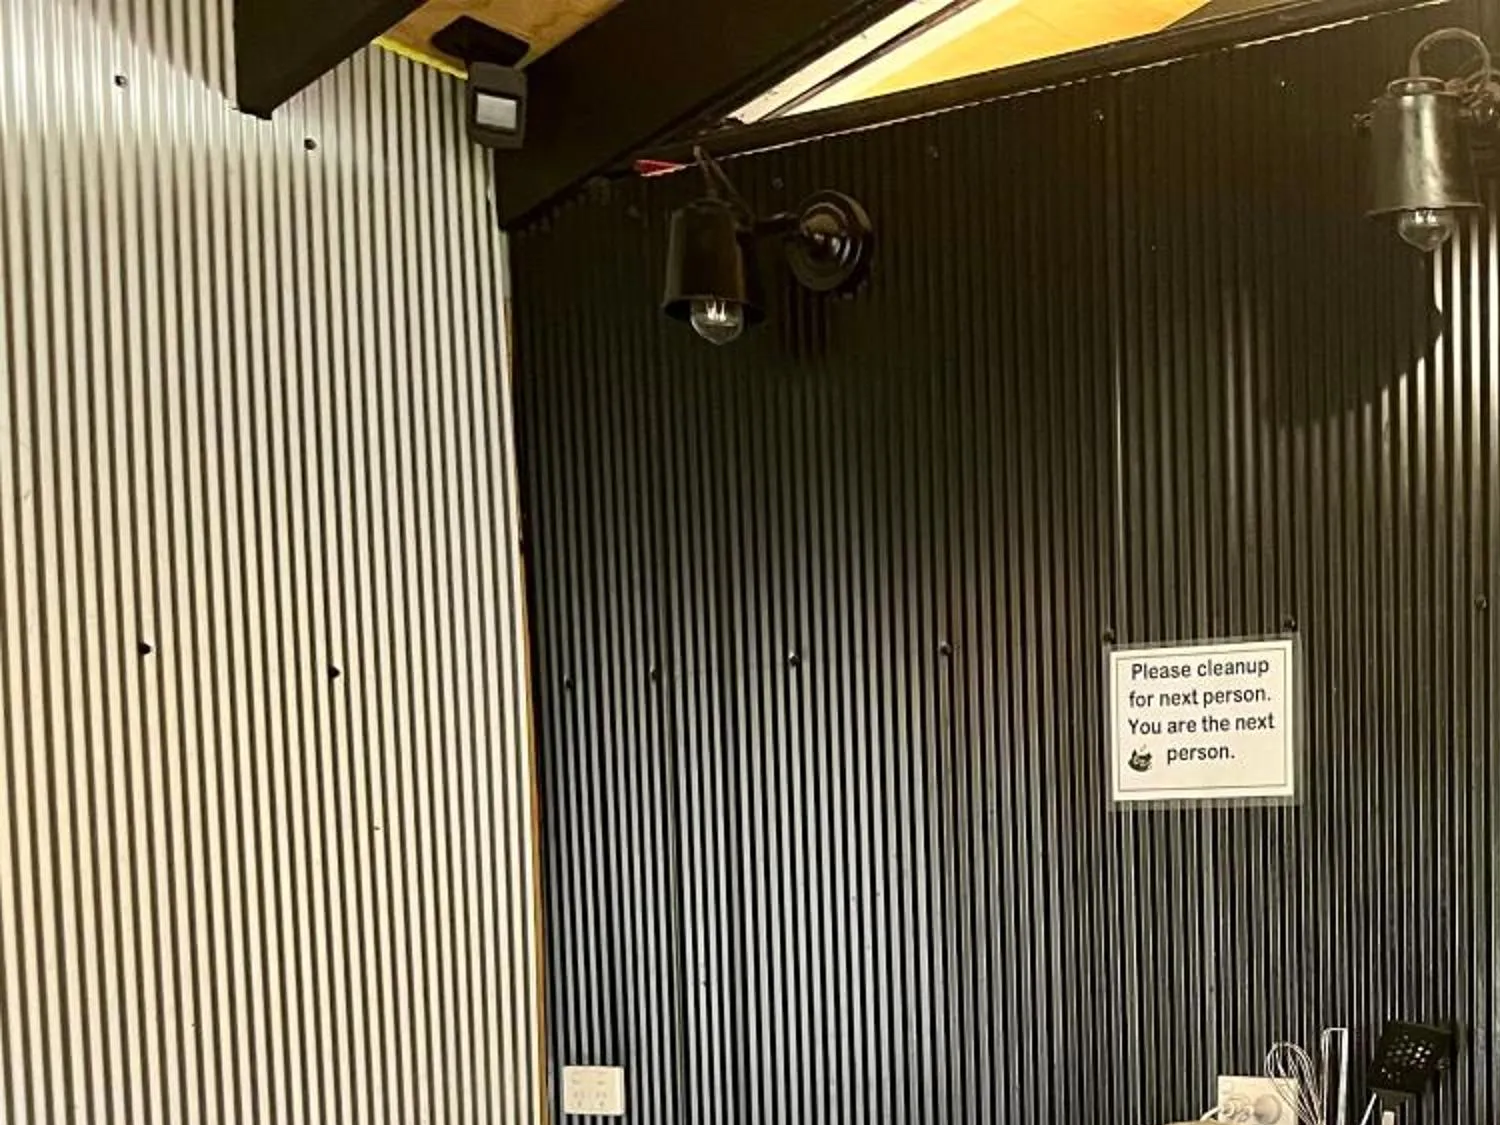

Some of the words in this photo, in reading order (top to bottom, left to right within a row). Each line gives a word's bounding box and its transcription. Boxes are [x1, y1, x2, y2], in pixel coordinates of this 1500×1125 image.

[1131, 662, 1191, 680] Please
[1197, 659, 1269, 677] cleanup
[1129, 689, 1154, 708] for
[1159, 689, 1199, 707] next
[1203, 687, 1271, 708] person.
[1128, 719, 1161, 735] You
[1167, 719, 1196, 733] are
[1202, 715, 1230, 732] the
[1235, 712, 1275, 731] next
[1167, 745, 1235, 765] person.
